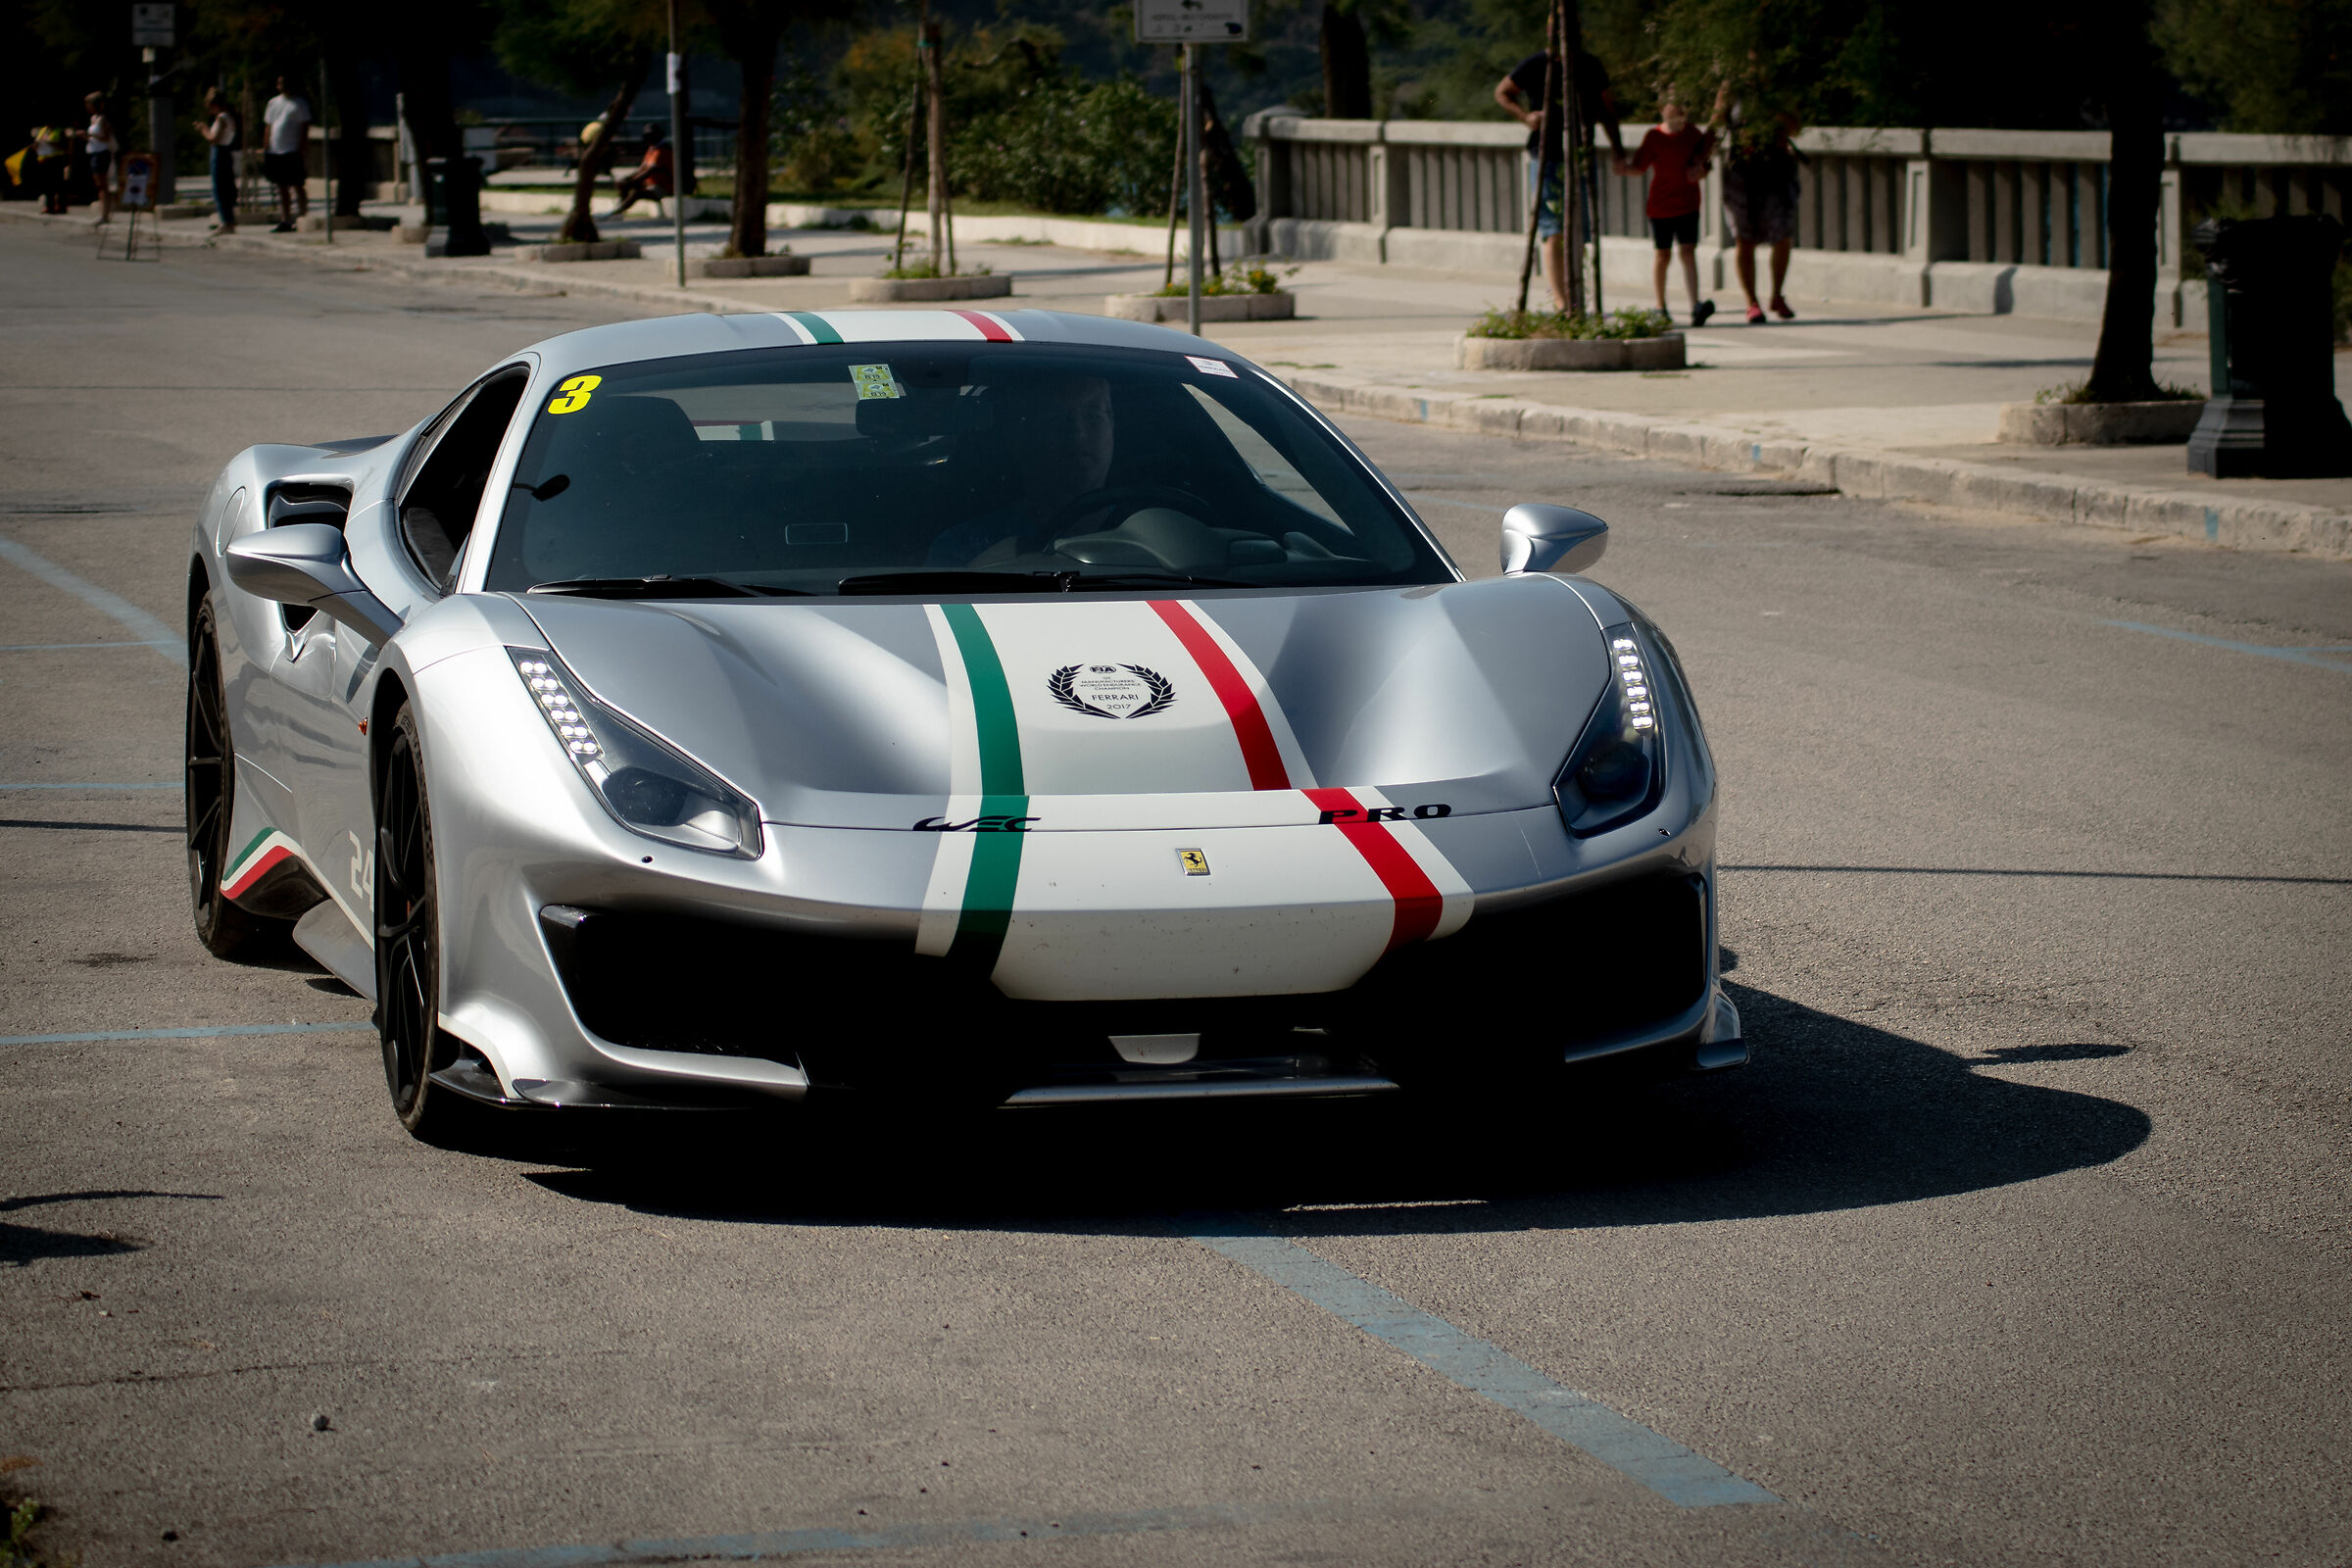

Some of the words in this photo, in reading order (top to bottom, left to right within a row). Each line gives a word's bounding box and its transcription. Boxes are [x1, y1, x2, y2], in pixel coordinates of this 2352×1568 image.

[548, 375, 602, 414] 3
[912, 815, 1042, 832] WEC
[1318, 804, 1451, 824] PRO
